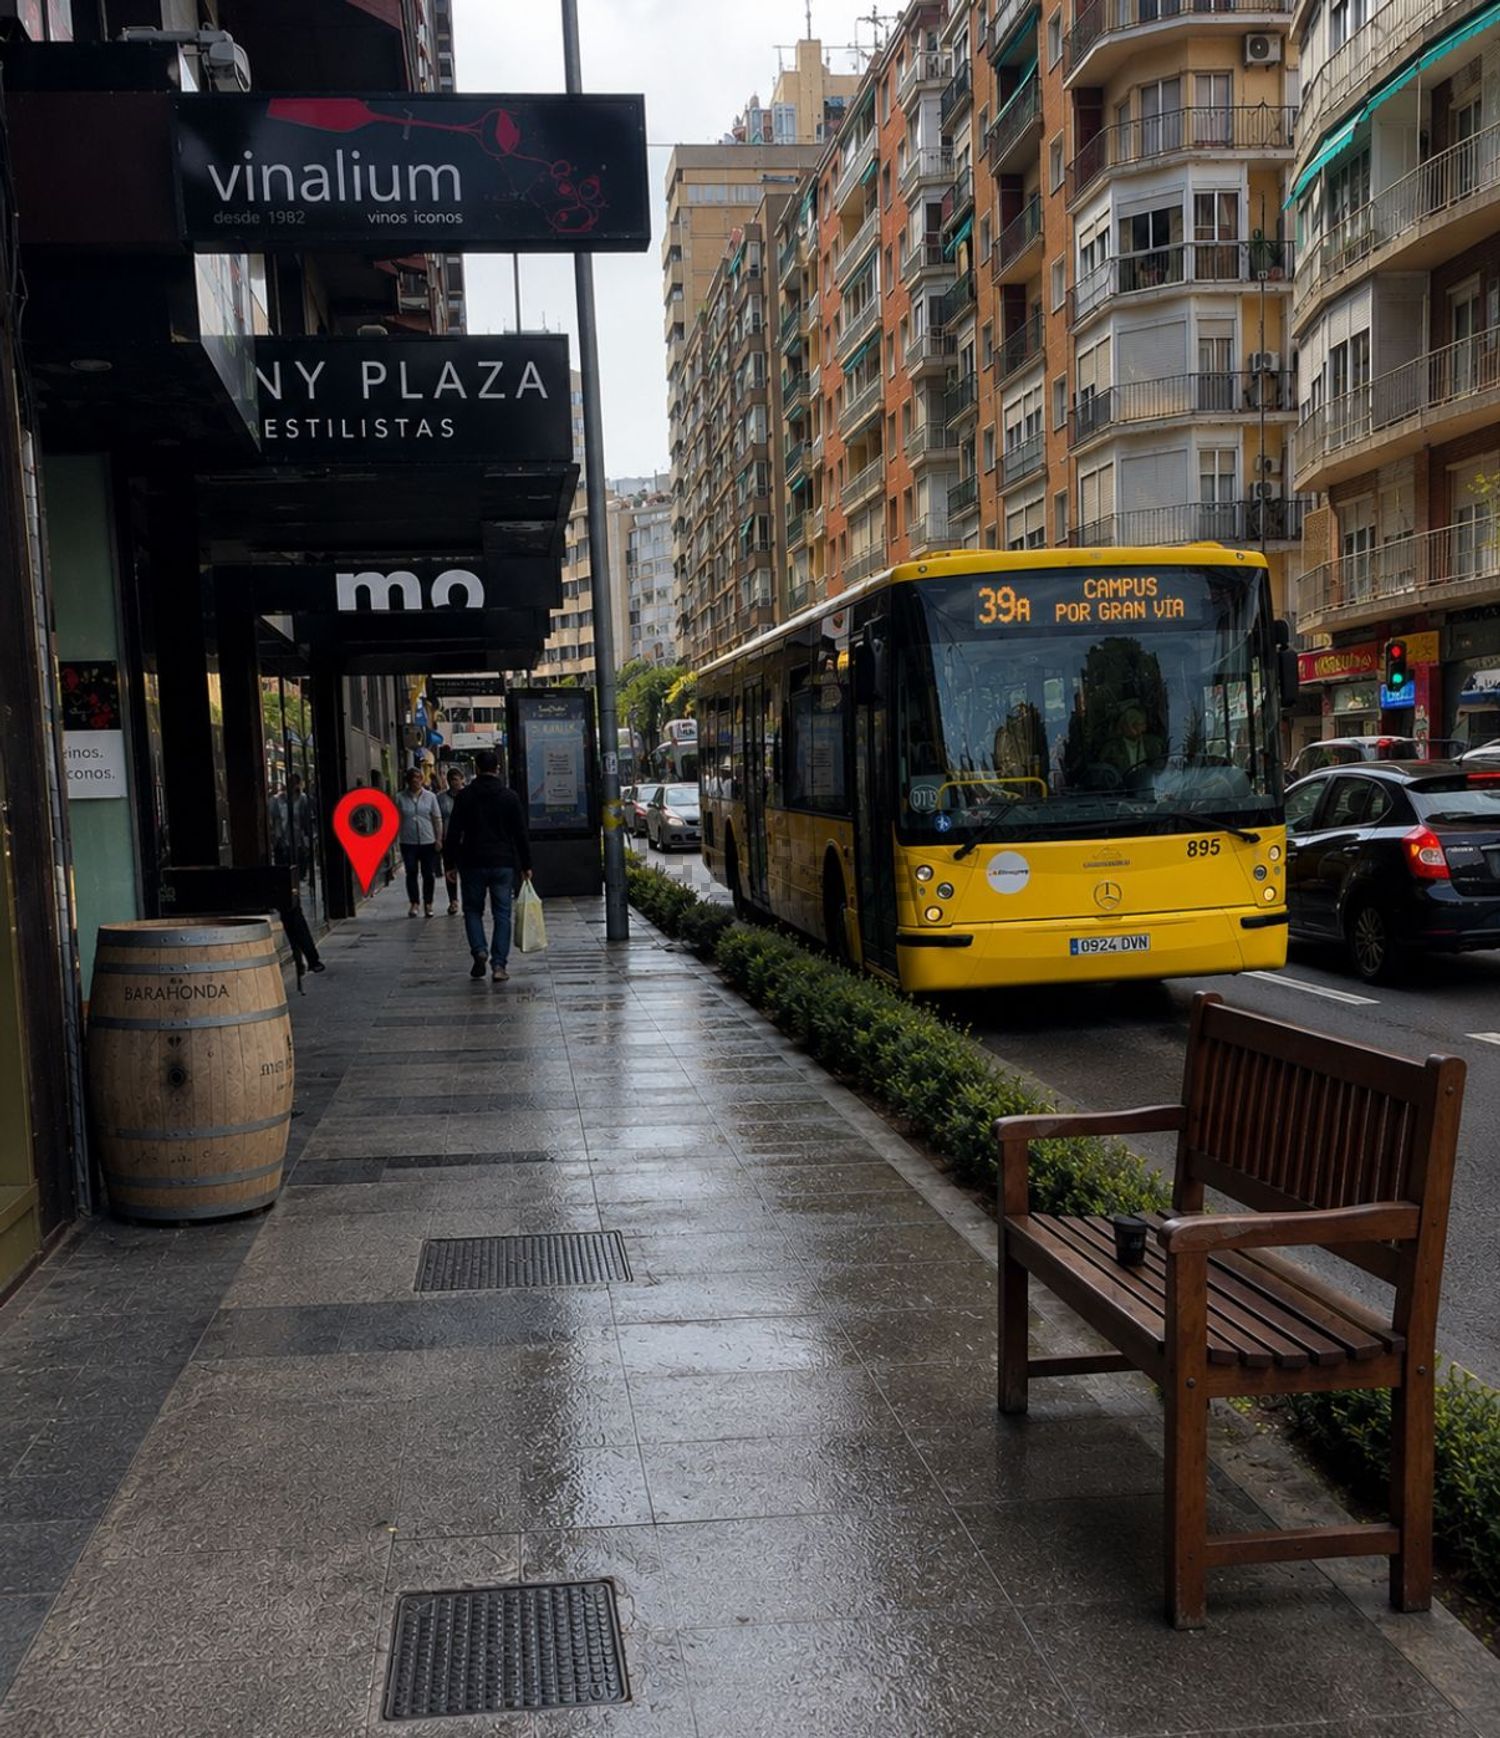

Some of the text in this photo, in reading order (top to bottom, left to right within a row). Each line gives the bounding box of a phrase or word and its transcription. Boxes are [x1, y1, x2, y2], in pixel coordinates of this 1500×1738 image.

[207, 149, 462, 202] vinalium
[213, 211, 306, 225] desde 1982
[367, 211, 464, 225] vinos iconos
[361, 361, 549, 400] PLAZA
[264, 418, 455, 439] ESTILISTAS
[335, 569, 485, 612] mo
[1083, 577, 1158, 599] CAMPUS
[978, 586, 1031, 624] 39A
[1055, 603, 1091, 623] POR
[1098, 601, 1146, 621] GRAN
[1186, 838, 1221, 858] 895
[1080, 936, 1148, 953] 0924 DVN
[124, 983, 230, 1002] BARAHONDA
